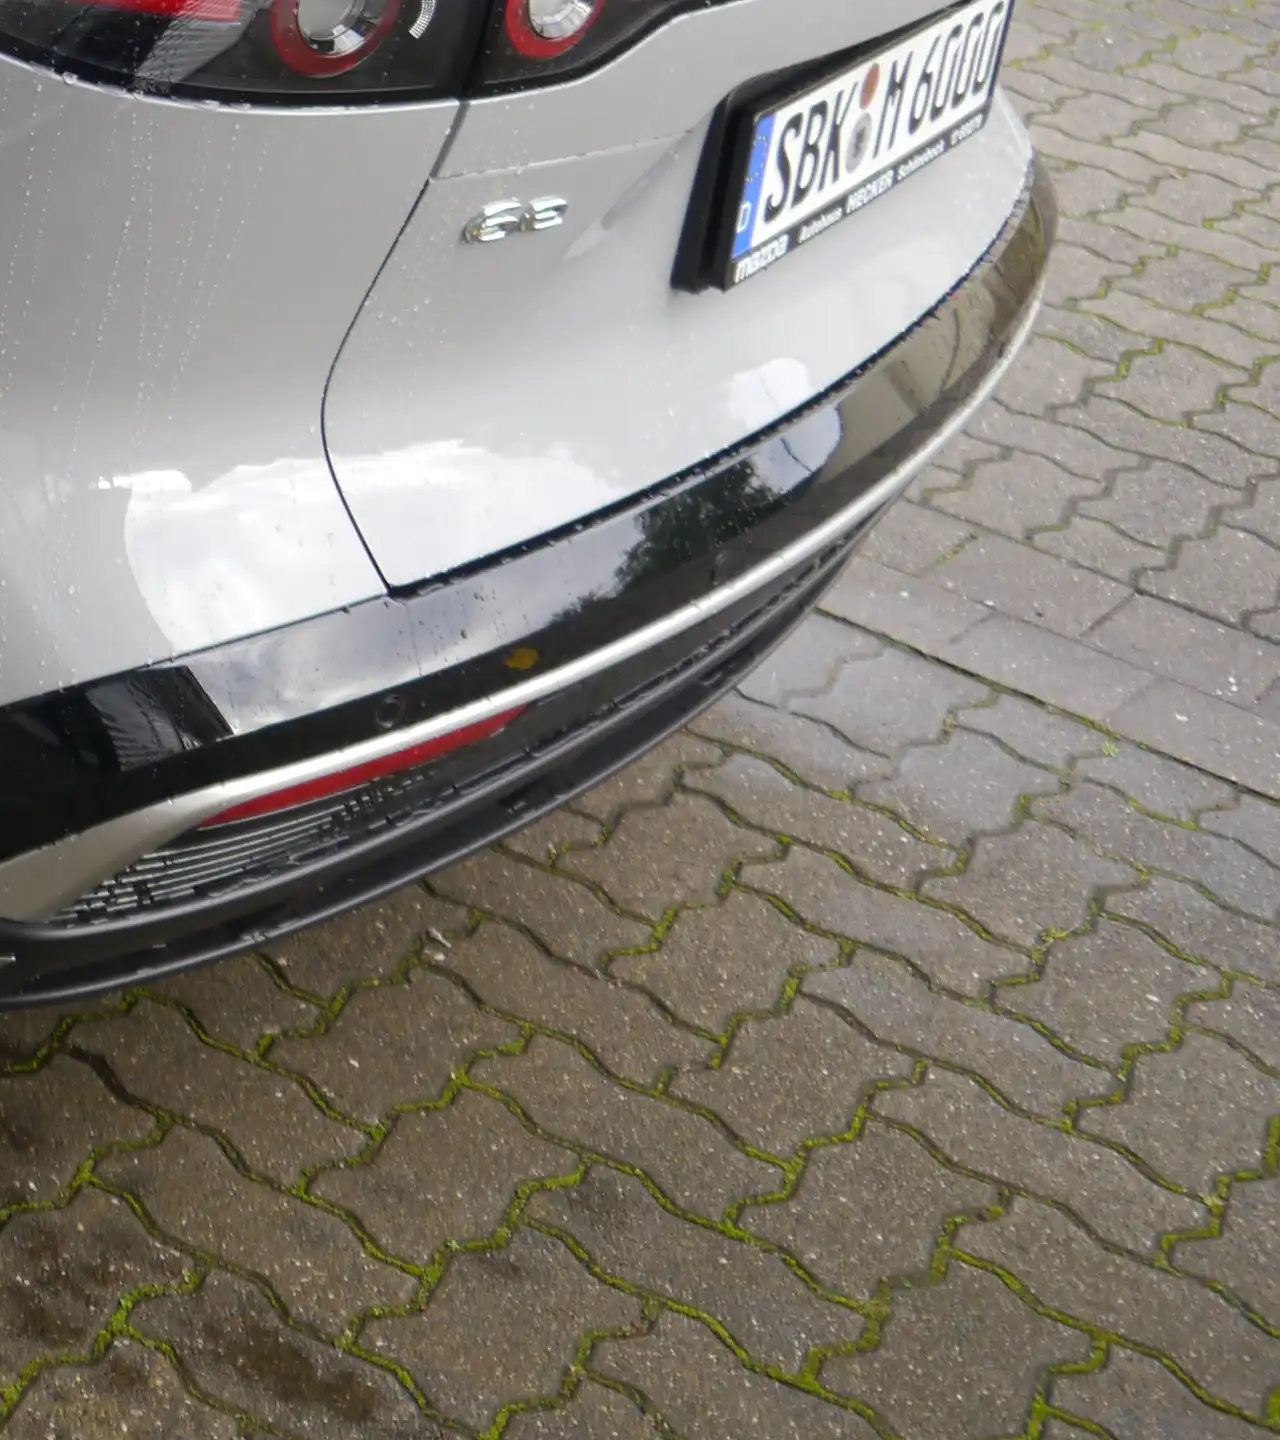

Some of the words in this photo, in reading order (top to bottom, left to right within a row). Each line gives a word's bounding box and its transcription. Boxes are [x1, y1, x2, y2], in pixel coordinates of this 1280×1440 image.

[763, 80, 859, 224] SBK
[736, 202, 752, 234] D
[798, 207, 842, 244] Autohaus
[846, 169, 894, 214] HECKER
